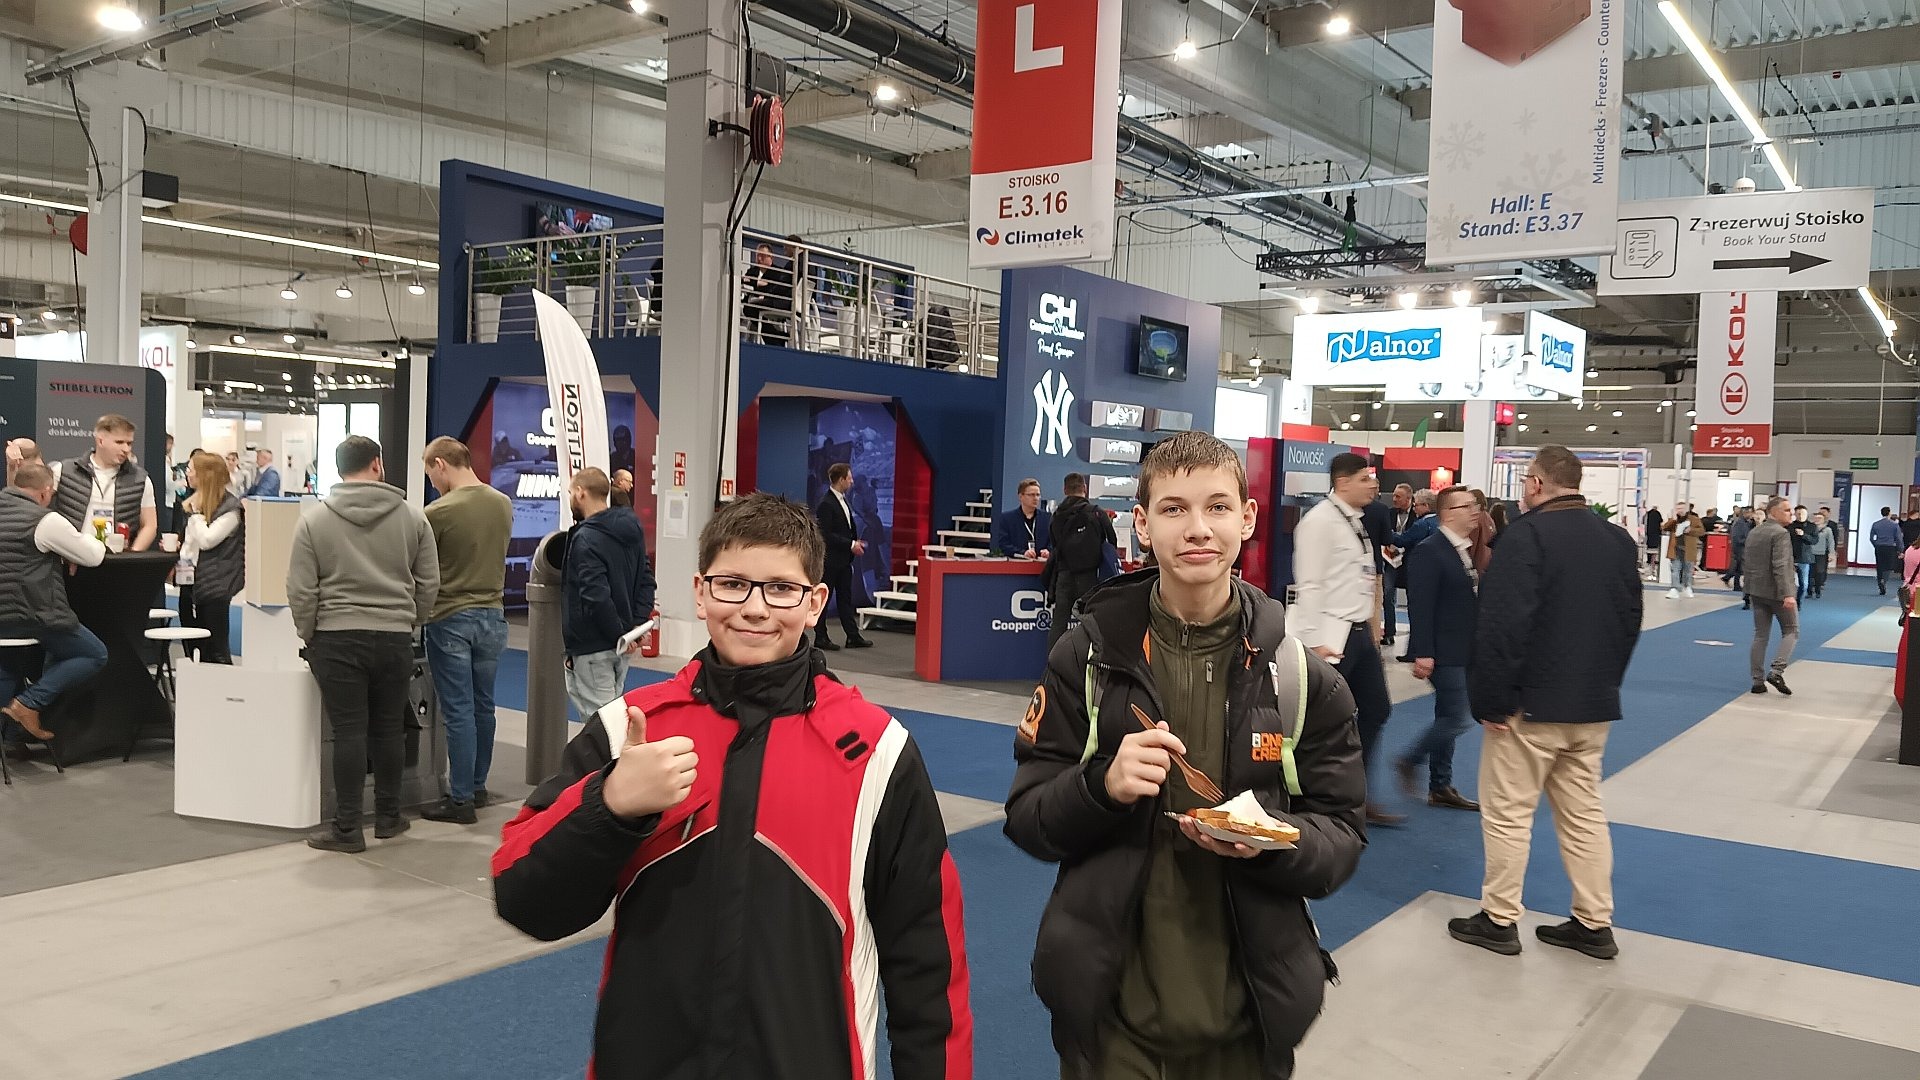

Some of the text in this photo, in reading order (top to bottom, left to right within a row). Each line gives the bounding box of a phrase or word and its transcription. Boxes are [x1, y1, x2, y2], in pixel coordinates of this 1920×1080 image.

[1014, 3, 1064, 73] L
[1595, 57, 1608, 107] Freezers
[1592, 118, 1607, 184] Multidecks
[1008, 172, 1060, 188] STOISKO
[999, 190, 1068, 219] E.3.16
[1490, 192, 1553, 214] Hall: E
[1459, 212, 1584, 238] Stand: E3.37
[1795, 209, 1865, 226] Stoisko
[1004, 225, 1083, 245] Climatek
[1037, 240, 1085, 249] NETWORK
[1723, 232, 1827, 246] Book Your Stand
[1040, 292, 1077, 328] CH
[1727, 292, 1747, 367] KOŁ
[49, 382, 134, 396] STIEBEL ELTRON
[48, 417, 65, 427] 100
[1710, 436, 1755, 448] F 2.30
[1288, 445, 1325, 466] Nowość
